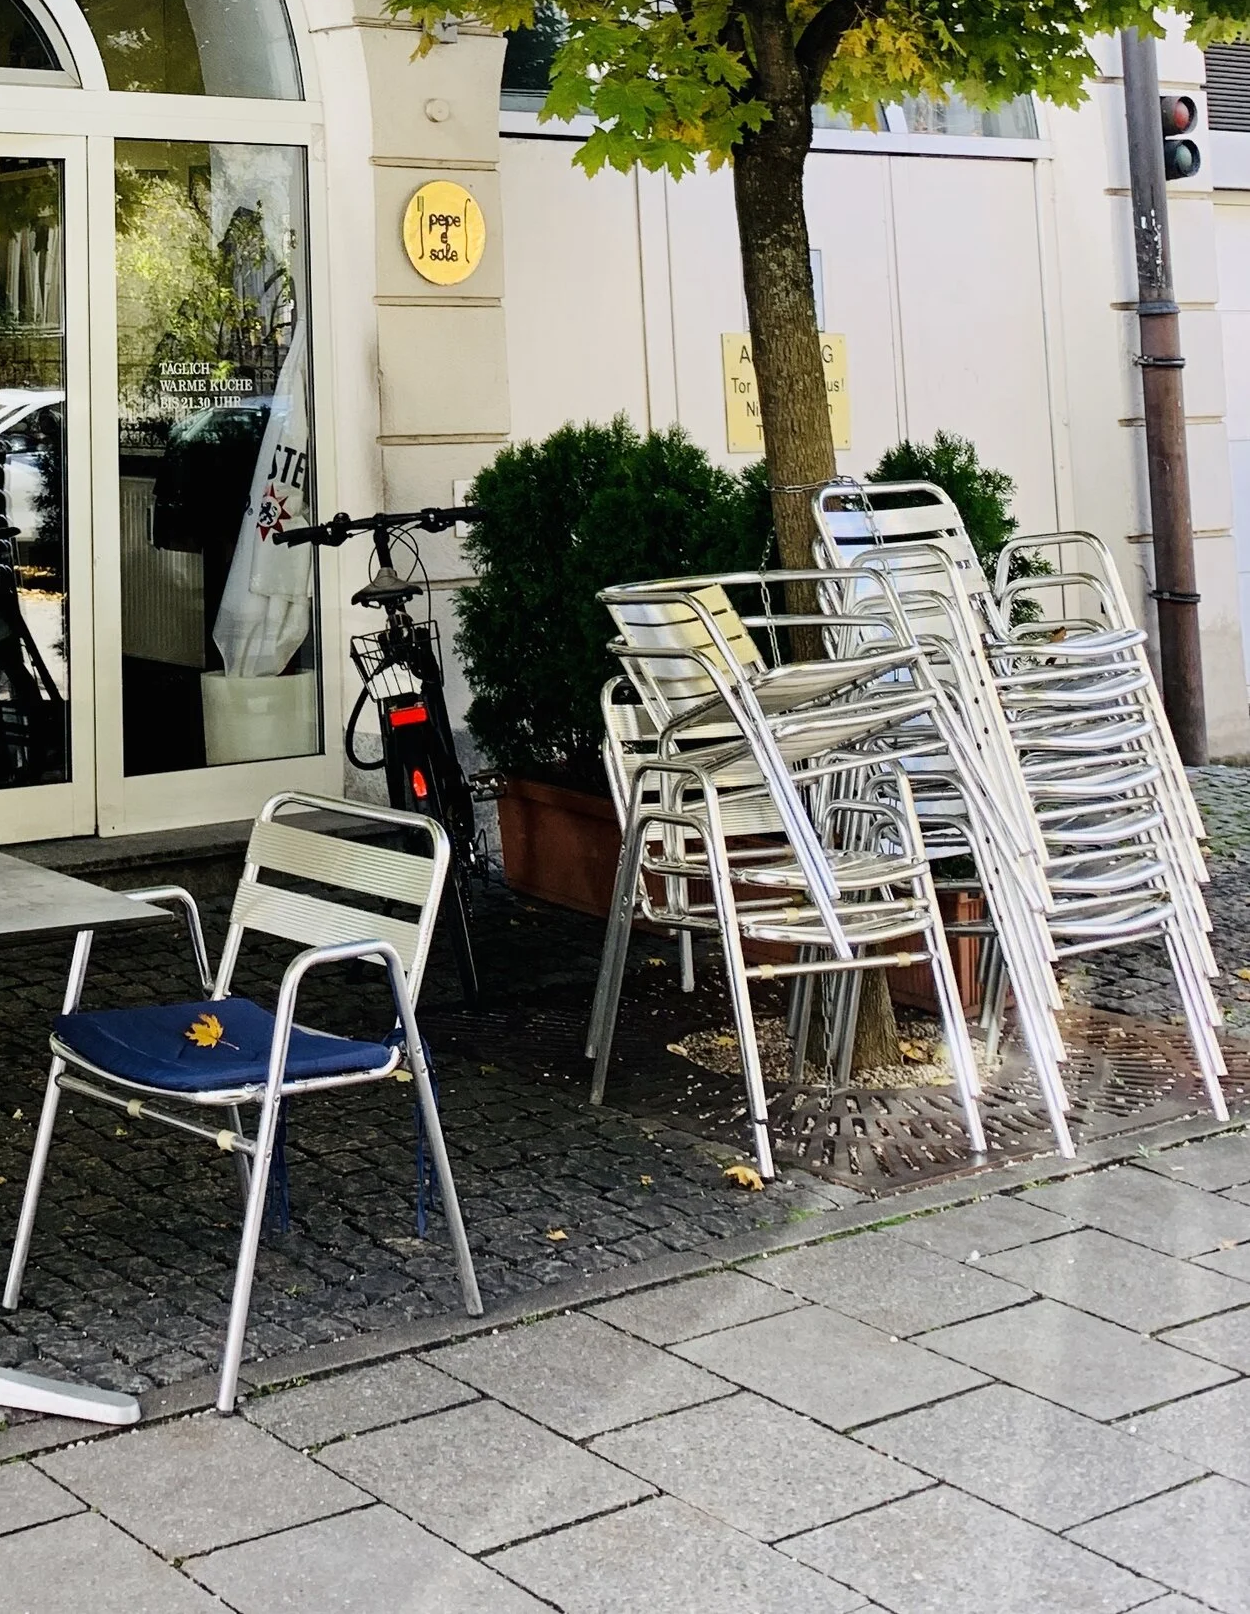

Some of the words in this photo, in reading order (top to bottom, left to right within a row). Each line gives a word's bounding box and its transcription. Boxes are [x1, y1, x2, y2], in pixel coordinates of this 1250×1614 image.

[428, 213, 461, 234] pepe
[440, 231, 449, 244] e
[429, 243, 459, 263] sale
[159, 379, 206, 392] WARME
[731, 377, 751, 394] Tor
[160, 396, 180, 409] BIS
[181, 396, 210, 409] 21.30
[214, 395, 242, 409] UHR
